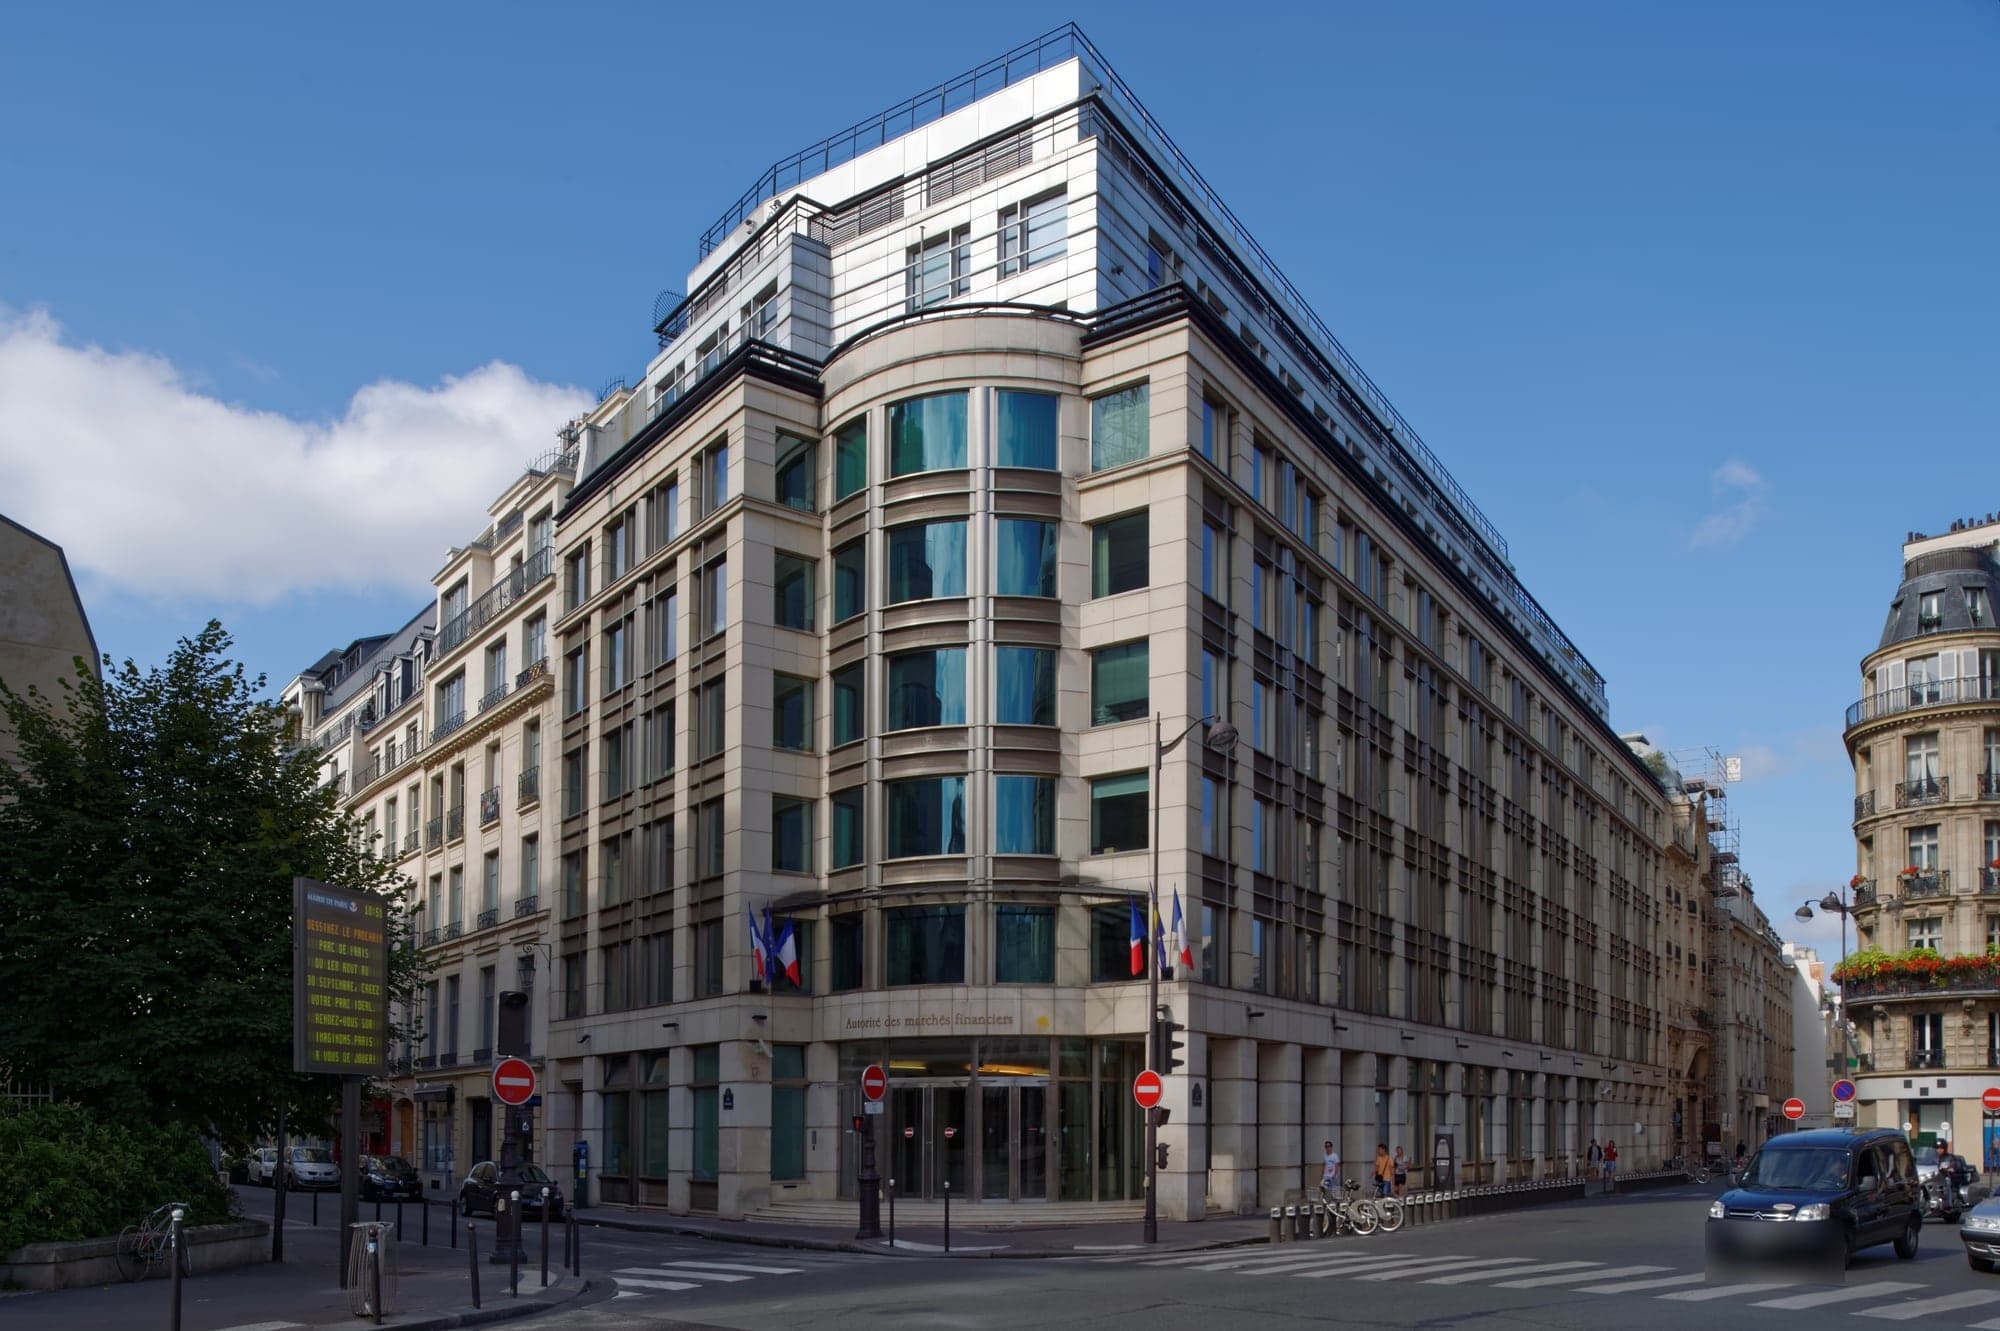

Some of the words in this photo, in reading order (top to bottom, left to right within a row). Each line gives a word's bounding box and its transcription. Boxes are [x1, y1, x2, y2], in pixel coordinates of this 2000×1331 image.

[334, 899, 349, 909] PARIS
[307, 919, 339, 935] DESSINEZ
[342, 926, 350, 938] LE
[319, 939, 335, 953] PARC
[338, 943, 347, 955] DE
[350, 944, 369, 959] PARIS
[361, 983, 381, 996] CREEZ
[311, 993, 332, 1007] VOTRE
[335, 997, 350, 1009] PARC
[315, 1013, 359, 1028] RENDEZ-VOUS
[846, 1016, 881, 1029] Autorité
[884, 1015, 901, 1027] des
[904, 1014, 951, 1026] marchés
[954, 1013, 1013, 1025] financiers
[323, 1049, 339, 1063] VOUS
